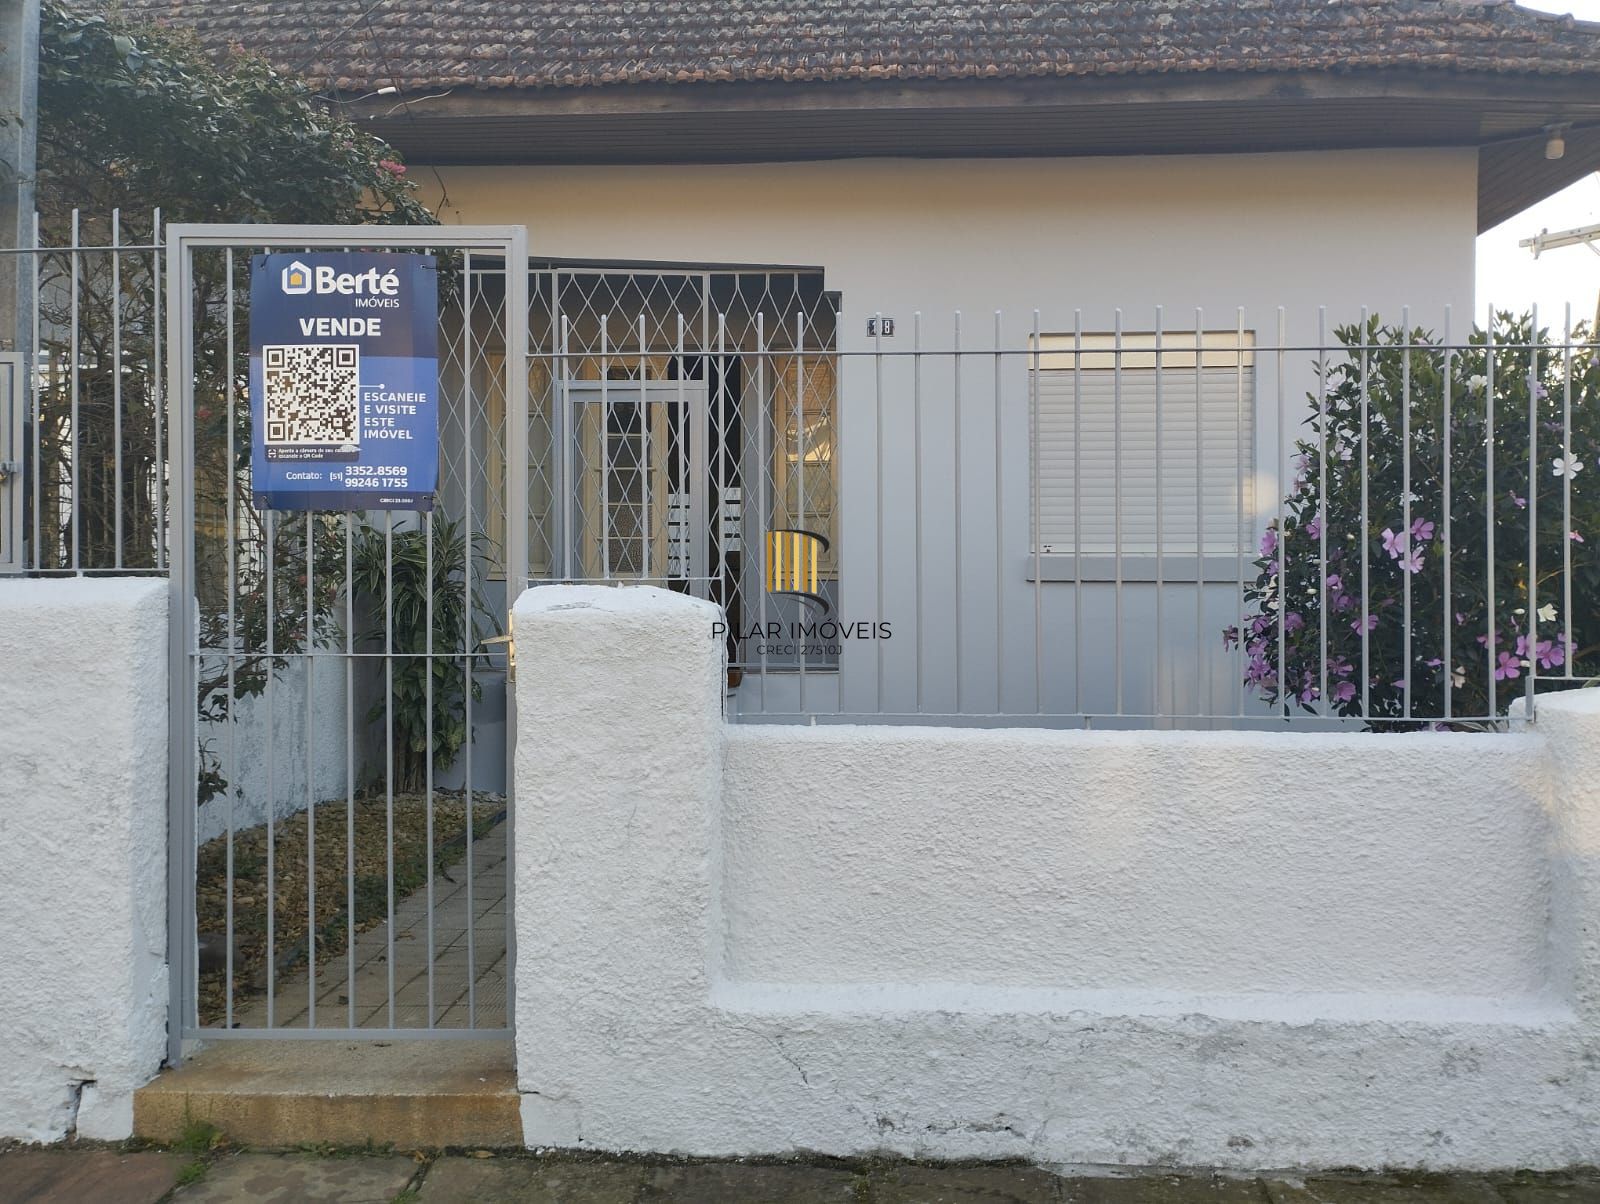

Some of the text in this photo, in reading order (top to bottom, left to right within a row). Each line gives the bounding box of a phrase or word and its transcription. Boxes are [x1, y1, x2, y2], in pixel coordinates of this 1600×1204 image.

[316, 267, 400, 295] Berté
[355, 296, 400, 308] IMÓVEIS
[299, 318, 381, 336] VENDE
[364, 392, 427, 402] ESCANEIE
[364, 405, 417, 415] E VISITE
[364, 417, 395, 427] ESTE
[364, 427, 413, 439] IMÓVEL
[286, 471, 322, 480] Contato:
[345, 466, 408, 476] 3352.8569
[345, 478, 408, 488] 99246 1755
